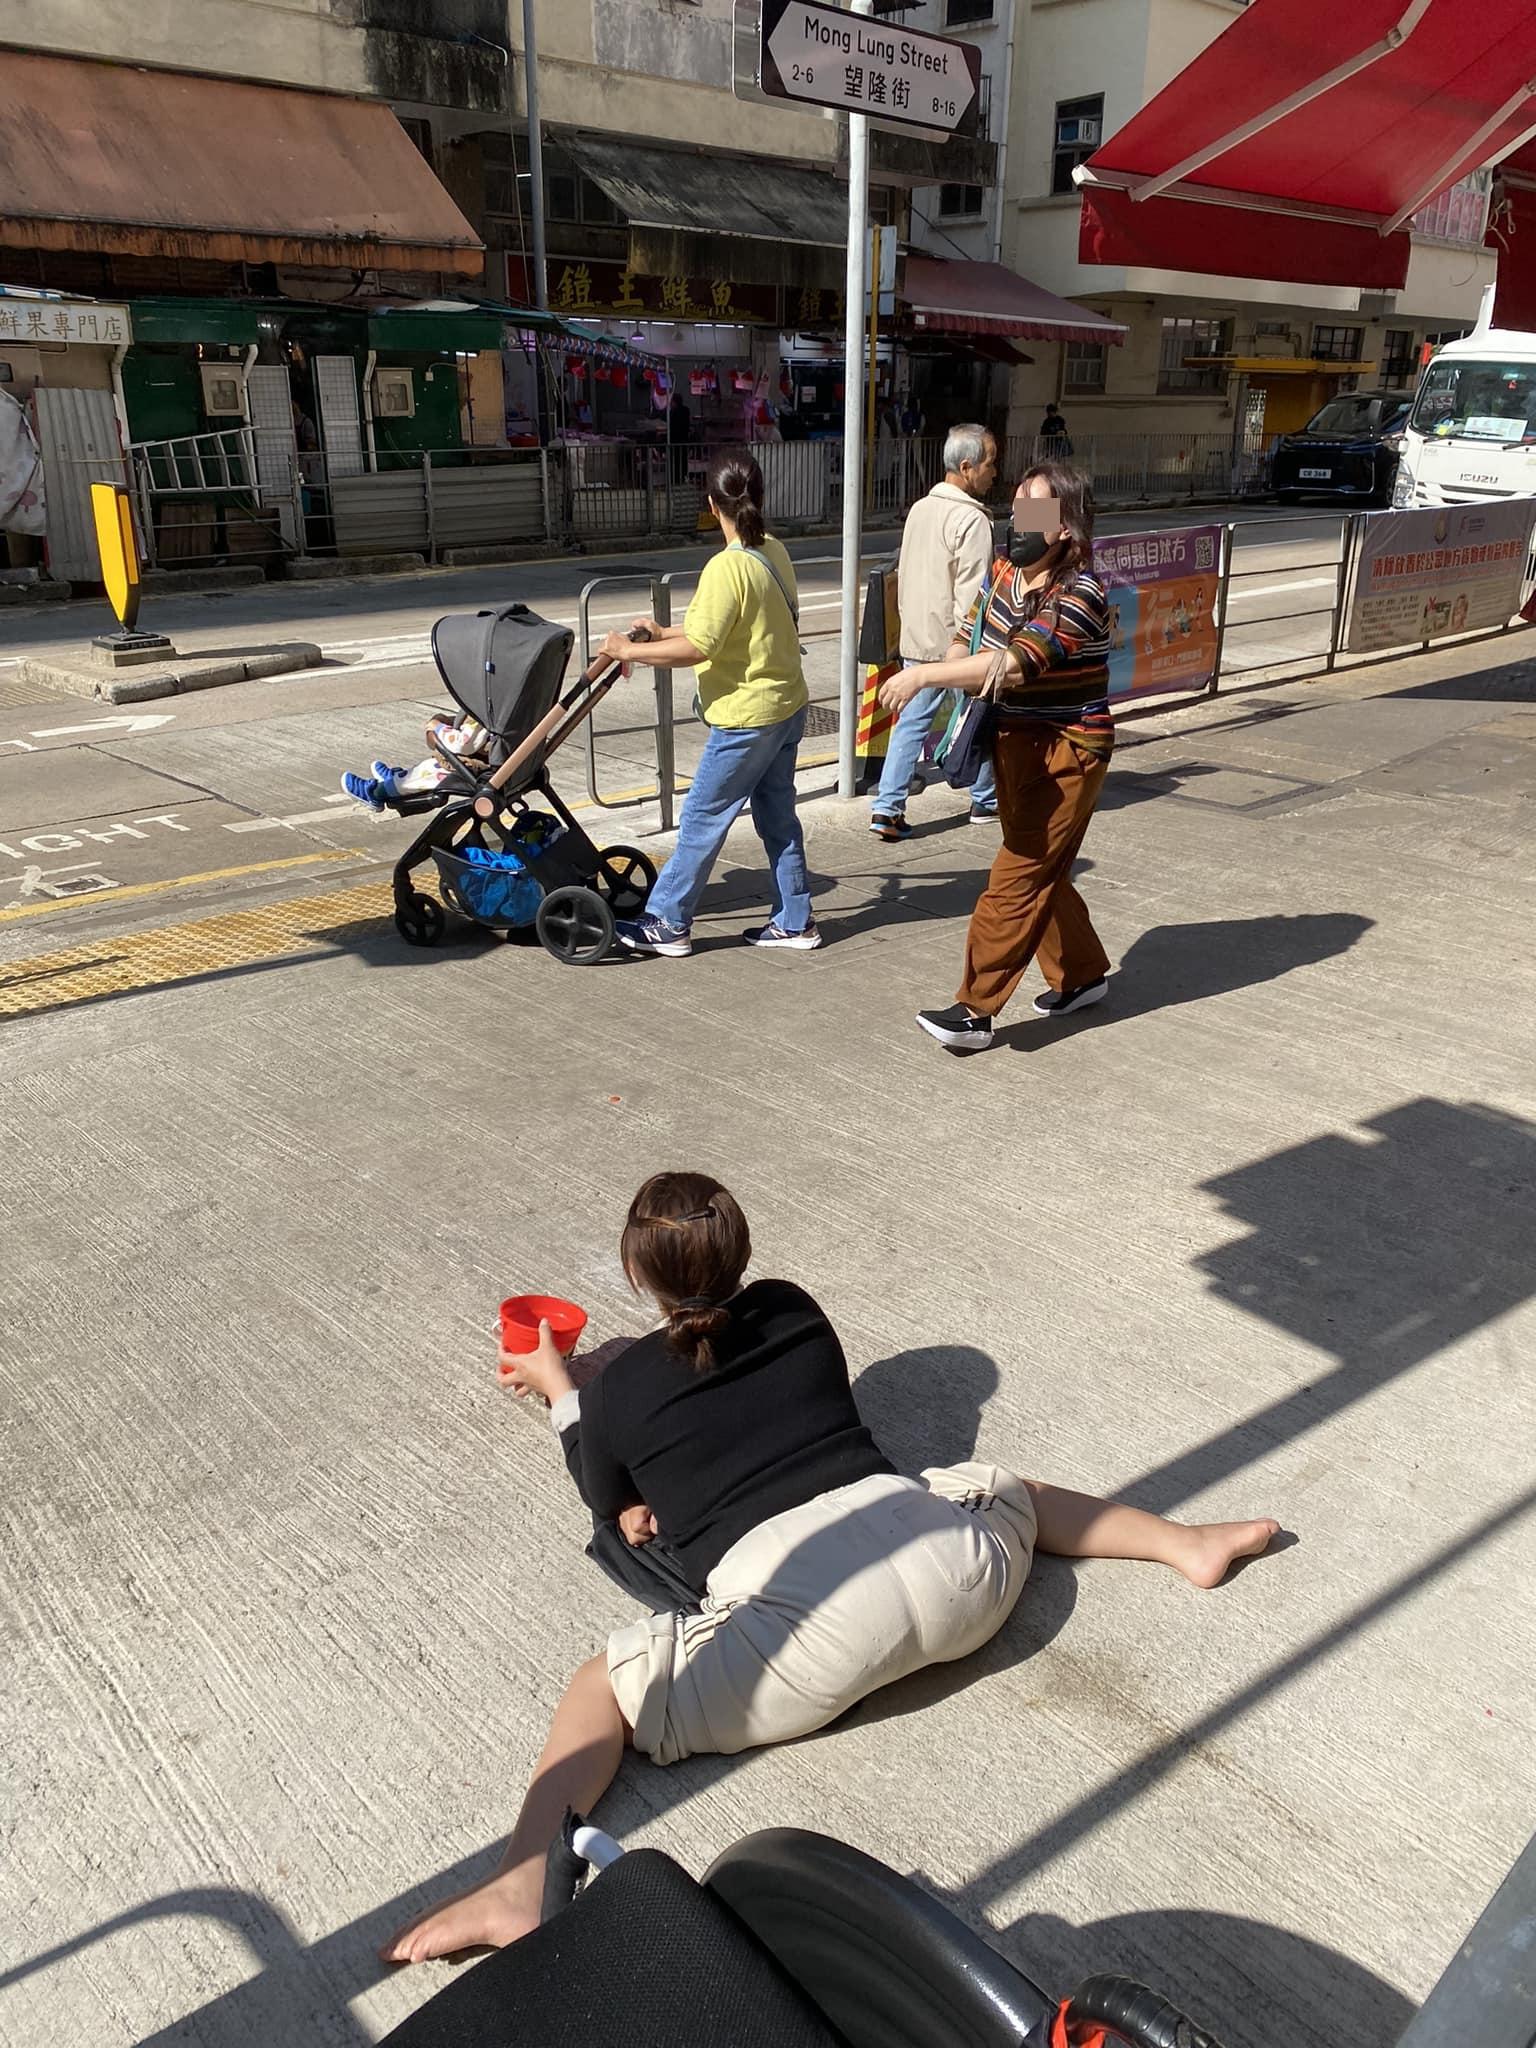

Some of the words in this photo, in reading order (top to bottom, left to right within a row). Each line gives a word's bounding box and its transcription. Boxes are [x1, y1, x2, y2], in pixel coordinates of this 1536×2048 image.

[804, 15, 852, 54] Mong
[857, 29, 895, 64] Lung
[900, 42, 949, 75] Street
[792, 64, 814, 84] 2-6
[844, 64, 911, 110] 望隆街
[932, 97, 956, 117] 8-16
[0, 308, 122, 341] 鮮果專門店
[1459, 472, 1499, 484] ISUZU
